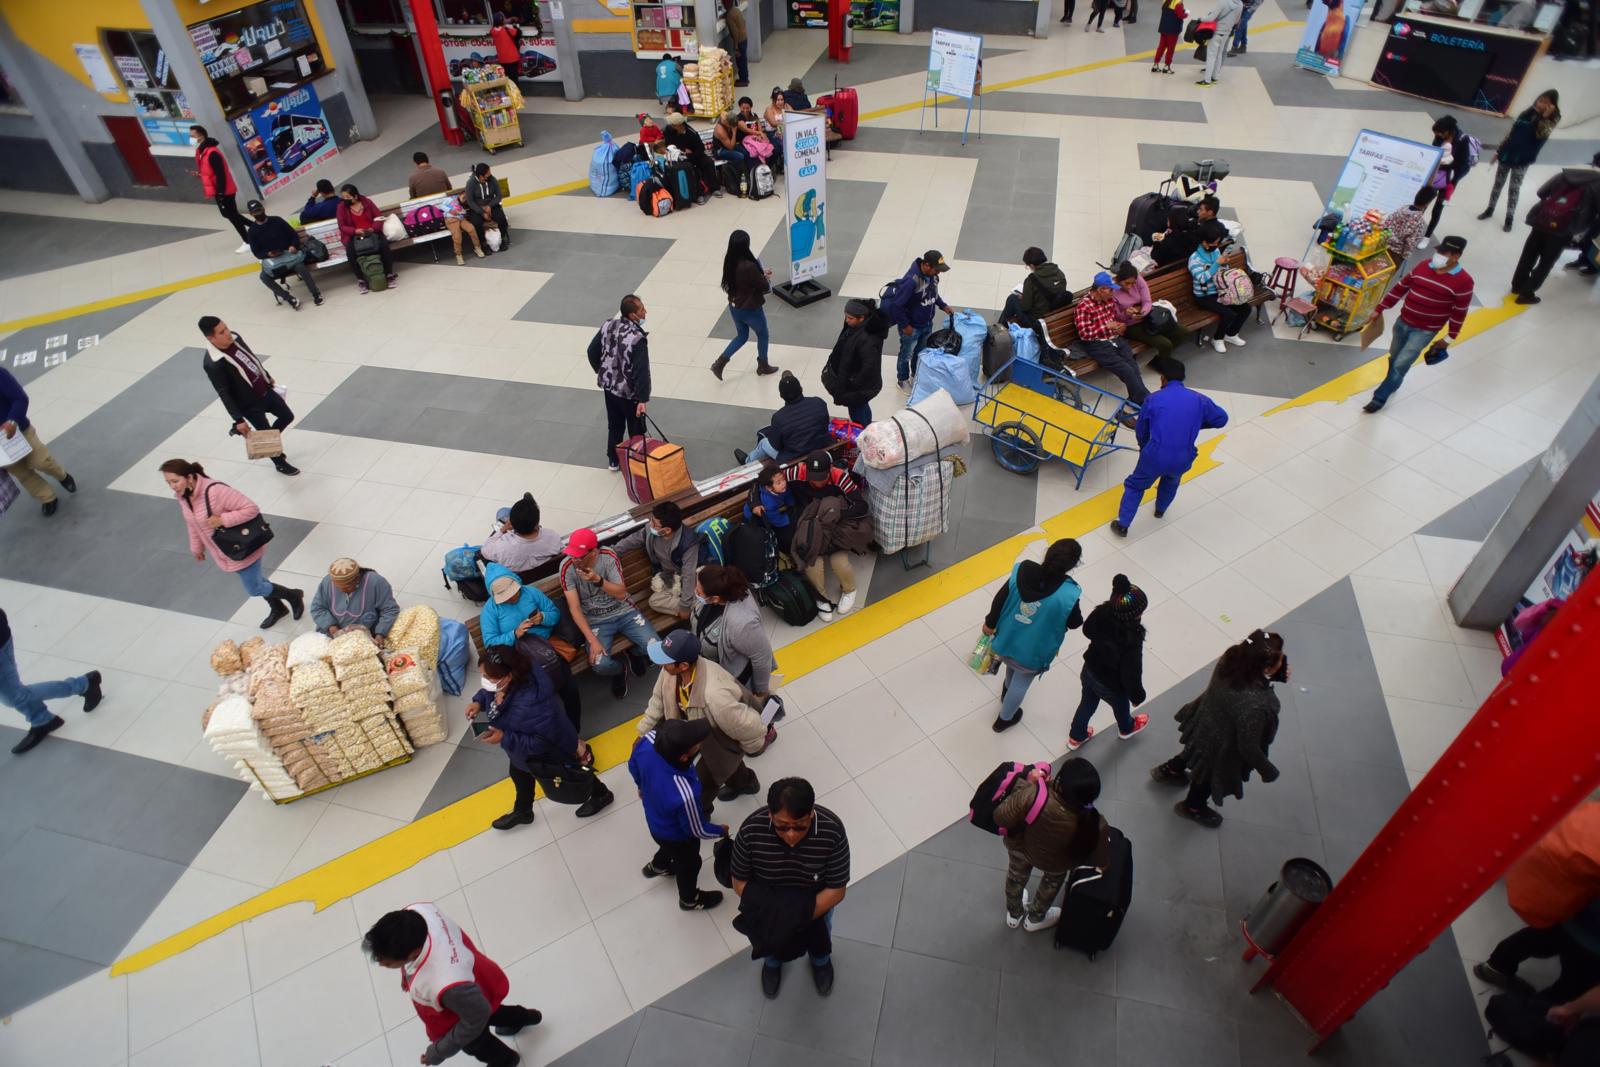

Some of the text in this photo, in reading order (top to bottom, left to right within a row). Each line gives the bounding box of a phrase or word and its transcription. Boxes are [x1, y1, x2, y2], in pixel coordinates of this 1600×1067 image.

[527, 38, 556, 47] SUCRE
[1429, 33, 1485, 51] BOLETERÍA
[795, 127, 818, 140] UN VIAJE
[794, 148, 820, 160] COMIENZA
[1359, 148, 1384, 160] TARIFAS
[804, 158, 812, 167] EN
[800, 166, 816, 176] CASA
